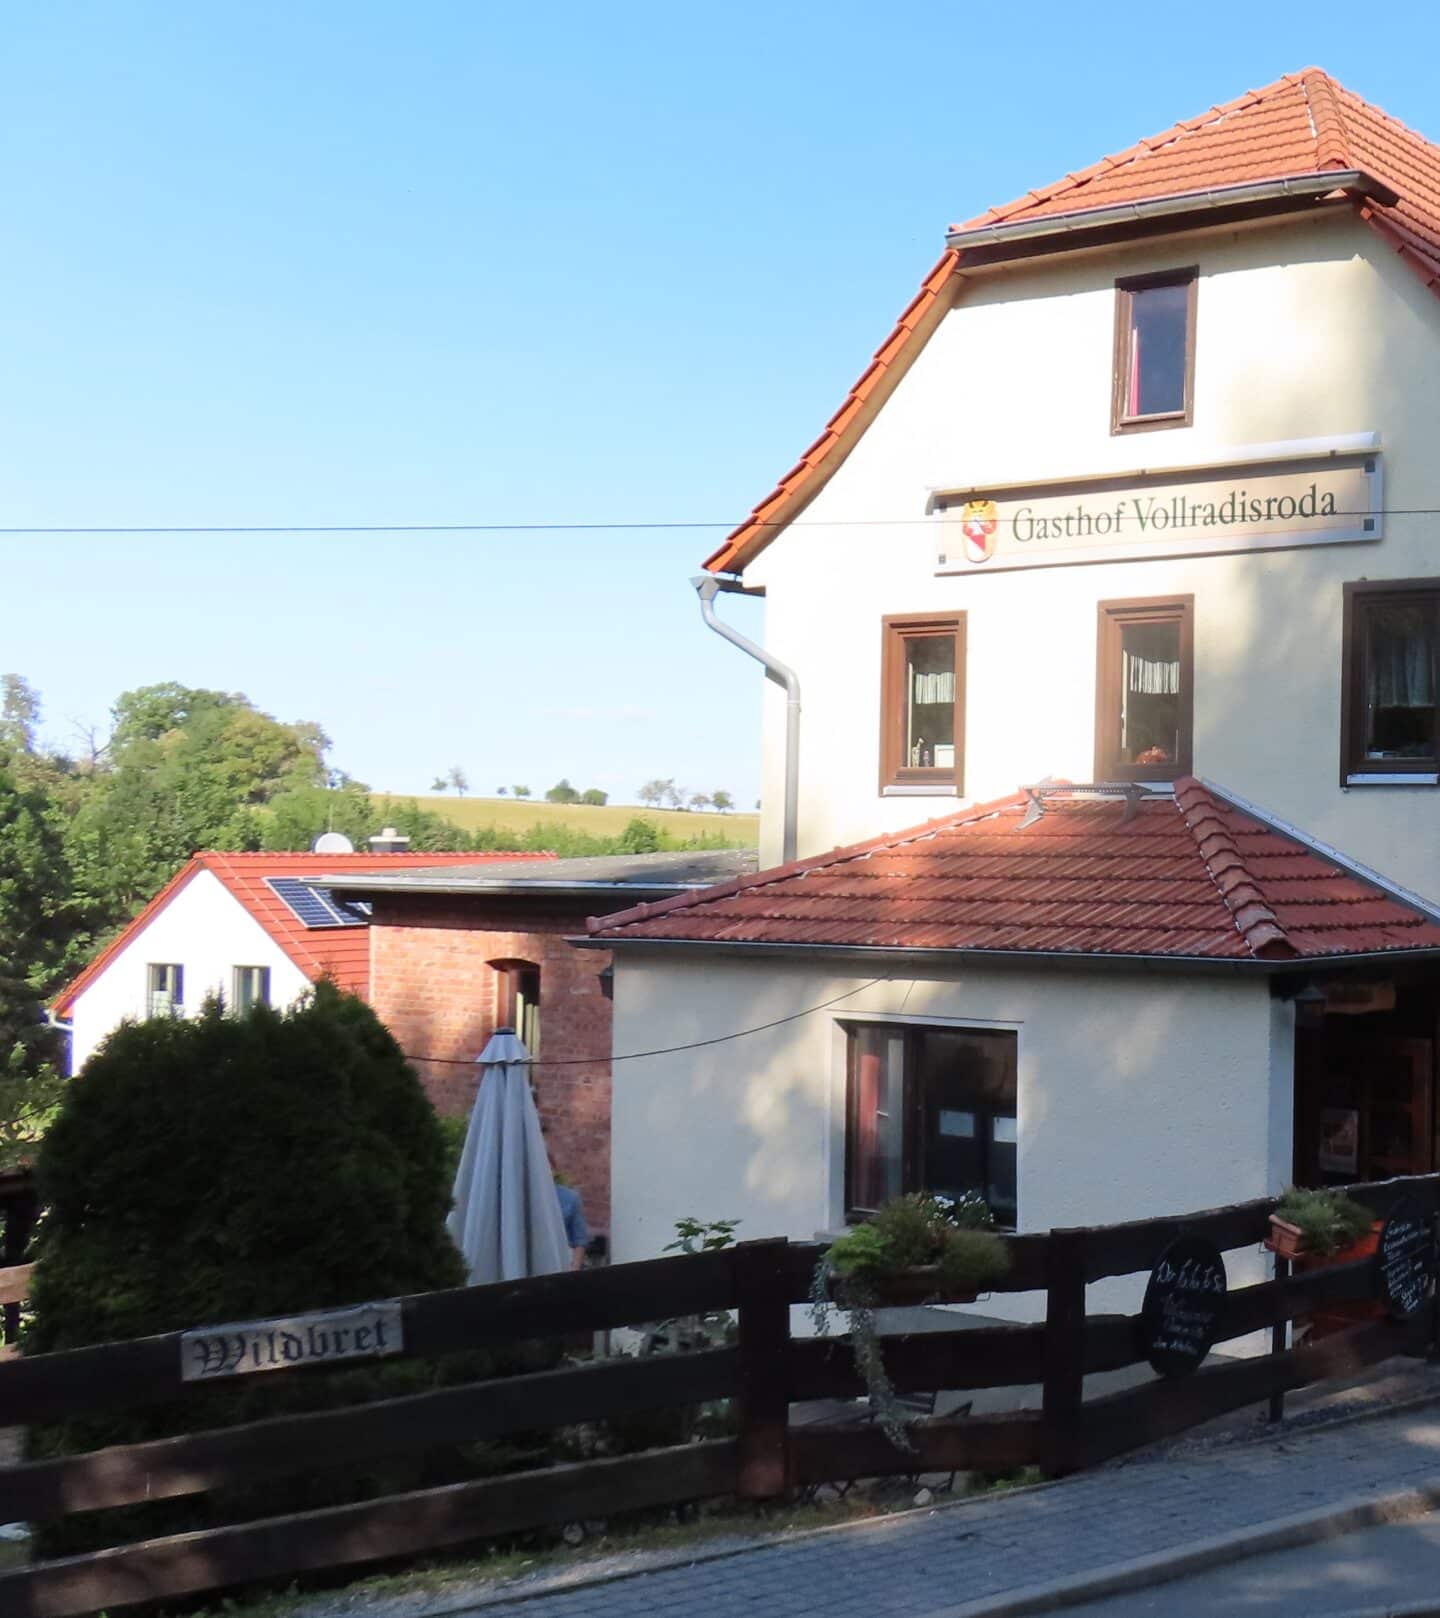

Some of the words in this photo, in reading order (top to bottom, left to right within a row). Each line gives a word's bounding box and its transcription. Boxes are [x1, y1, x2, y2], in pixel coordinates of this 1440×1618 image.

[1012, 502, 1126, 542] Gasthof
[1132, 485, 1337, 532] Vollradisroda
[193, 1318, 388, 1375] Wildbret
